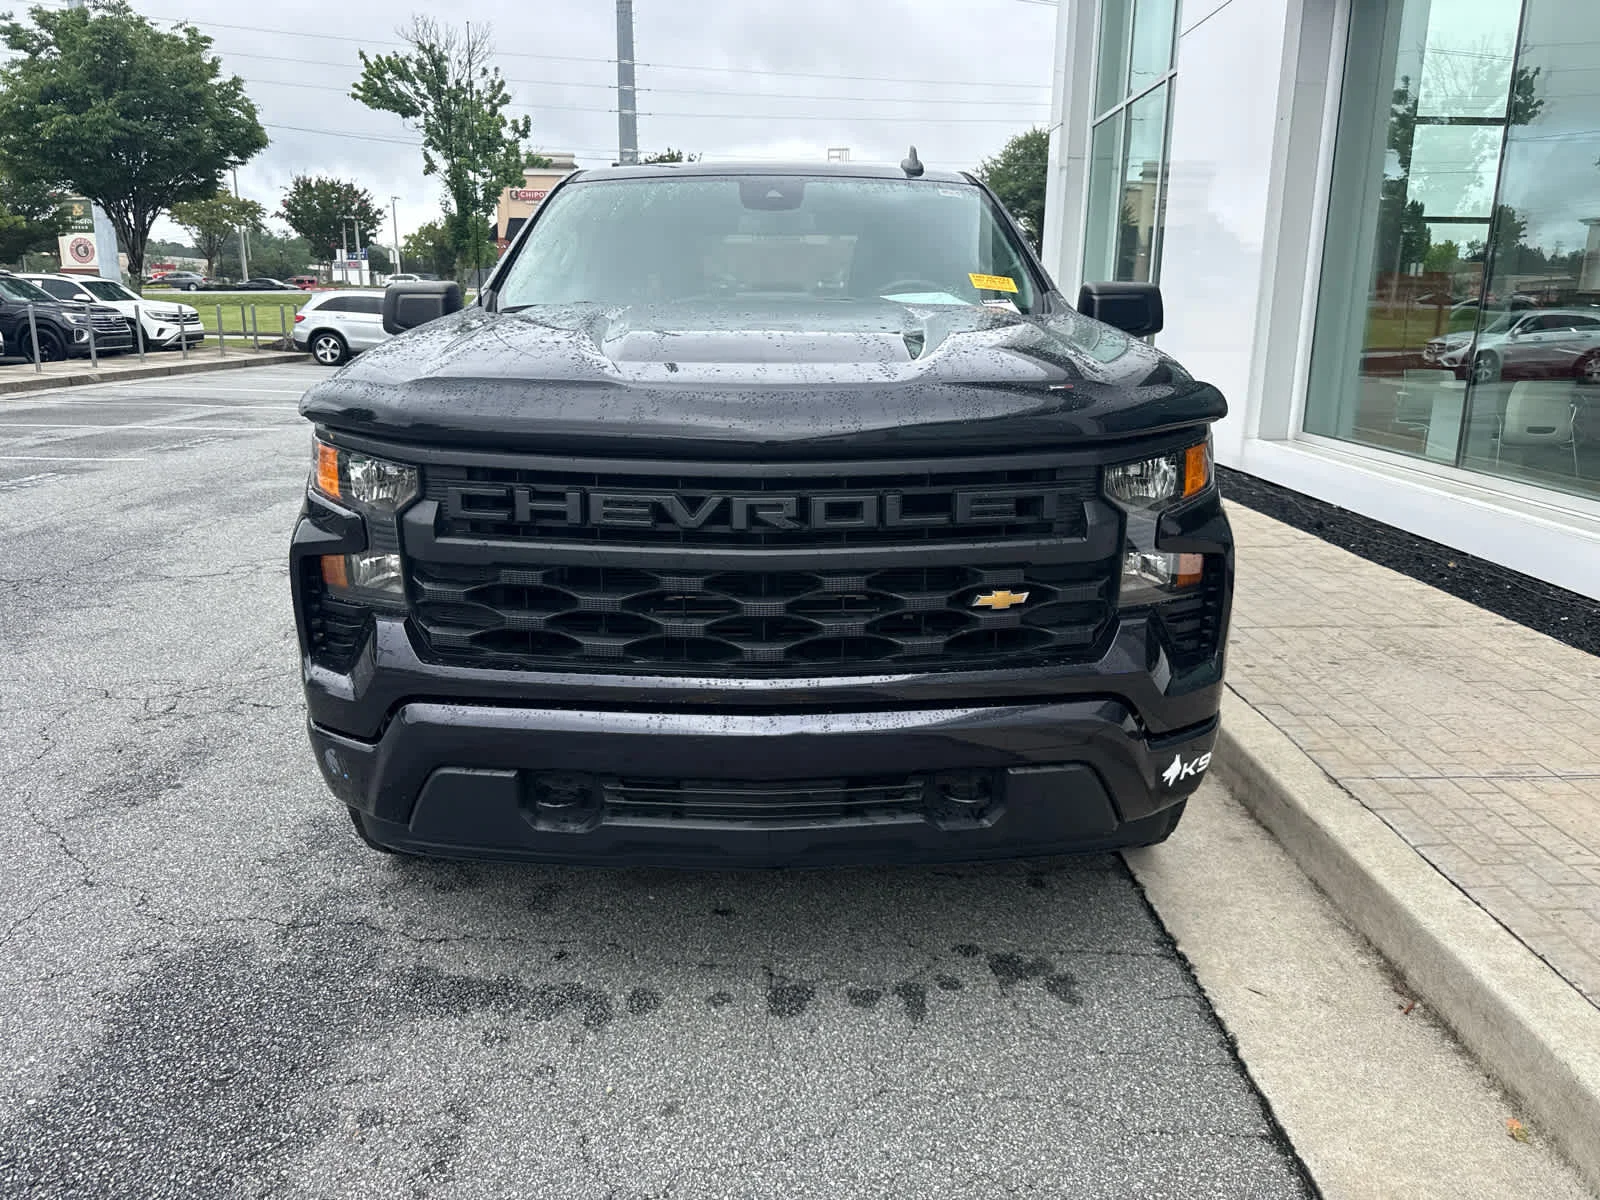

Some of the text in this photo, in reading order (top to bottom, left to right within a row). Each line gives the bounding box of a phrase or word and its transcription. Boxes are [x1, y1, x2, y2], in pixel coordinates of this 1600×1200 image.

[520, 191, 547, 199] CHIPO
[446, 484, 1068, 531] CHEVROLET
[1179, 752, 1212, 780] K9
